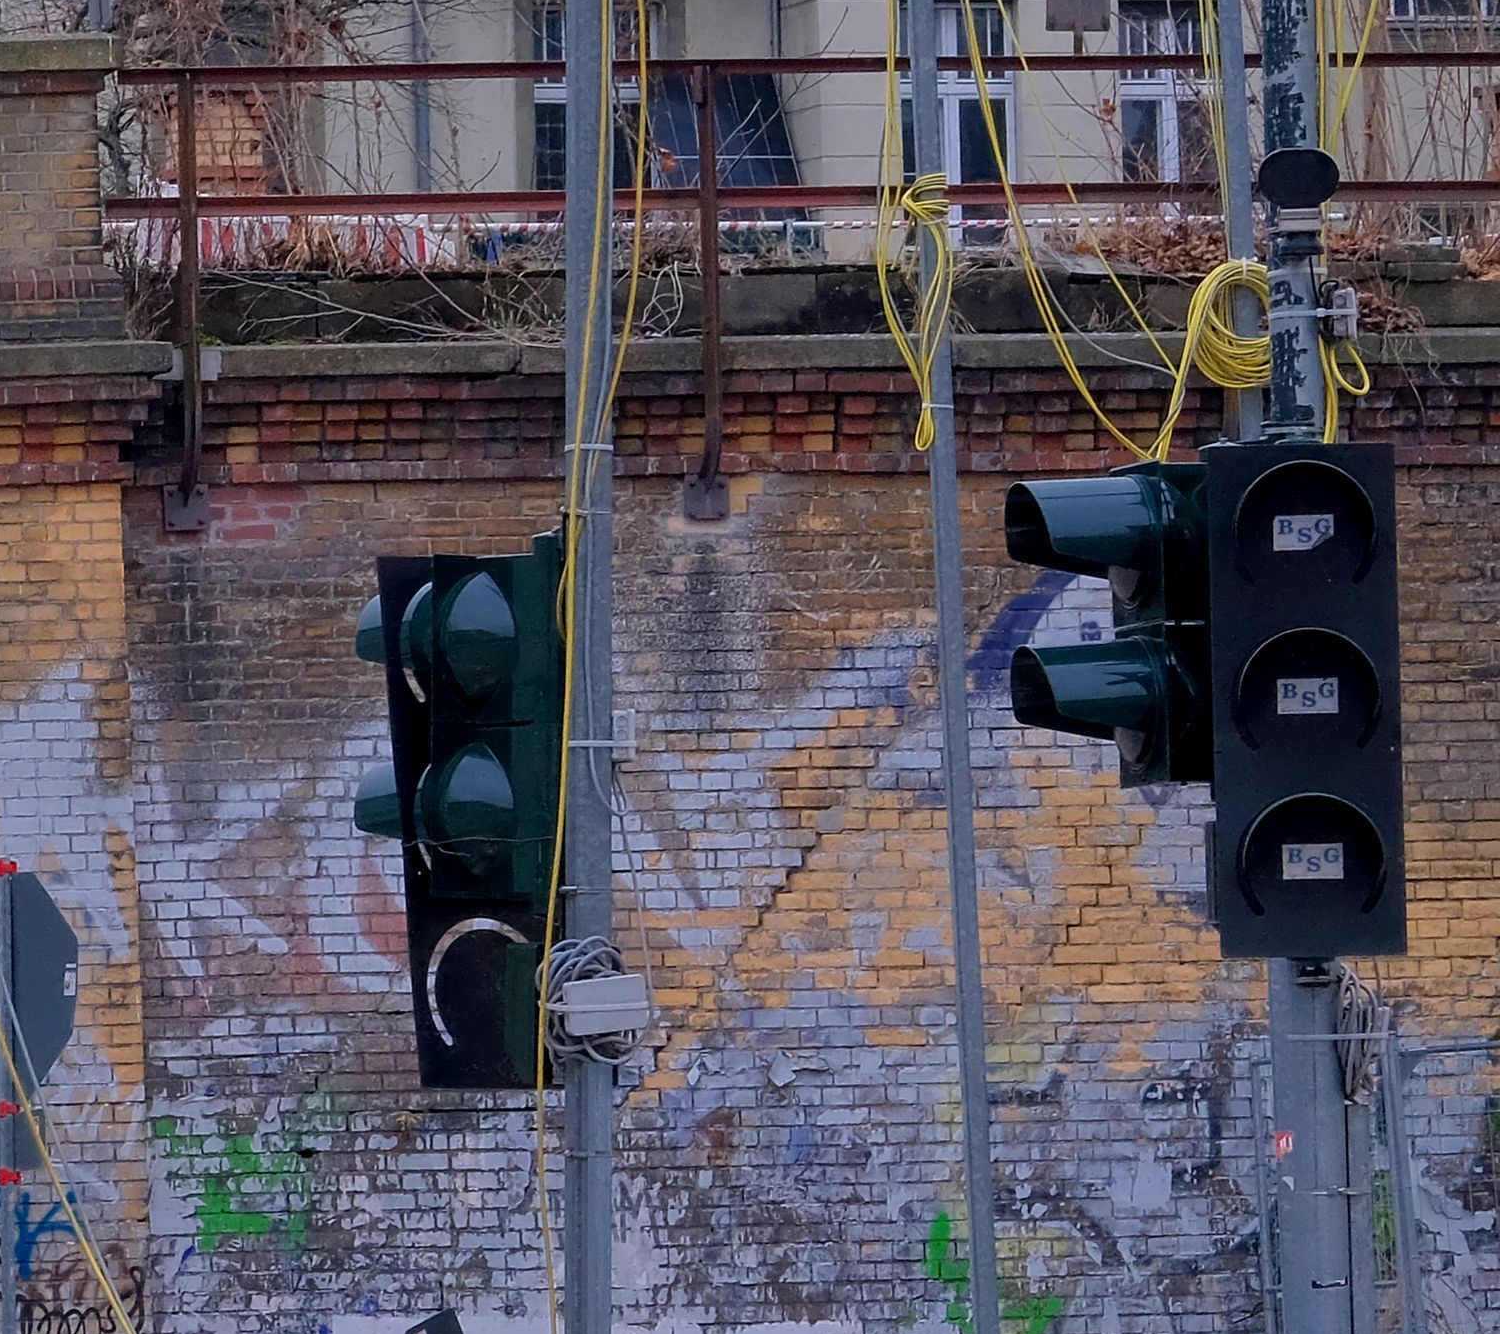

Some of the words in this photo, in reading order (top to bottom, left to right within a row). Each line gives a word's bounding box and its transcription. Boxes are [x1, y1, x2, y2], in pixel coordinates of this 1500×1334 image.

[1278, 519, 1332, 544] BSG
[1282, 679, 1337, 708] BSG
[1287, 842, 1341, 872] BSG
